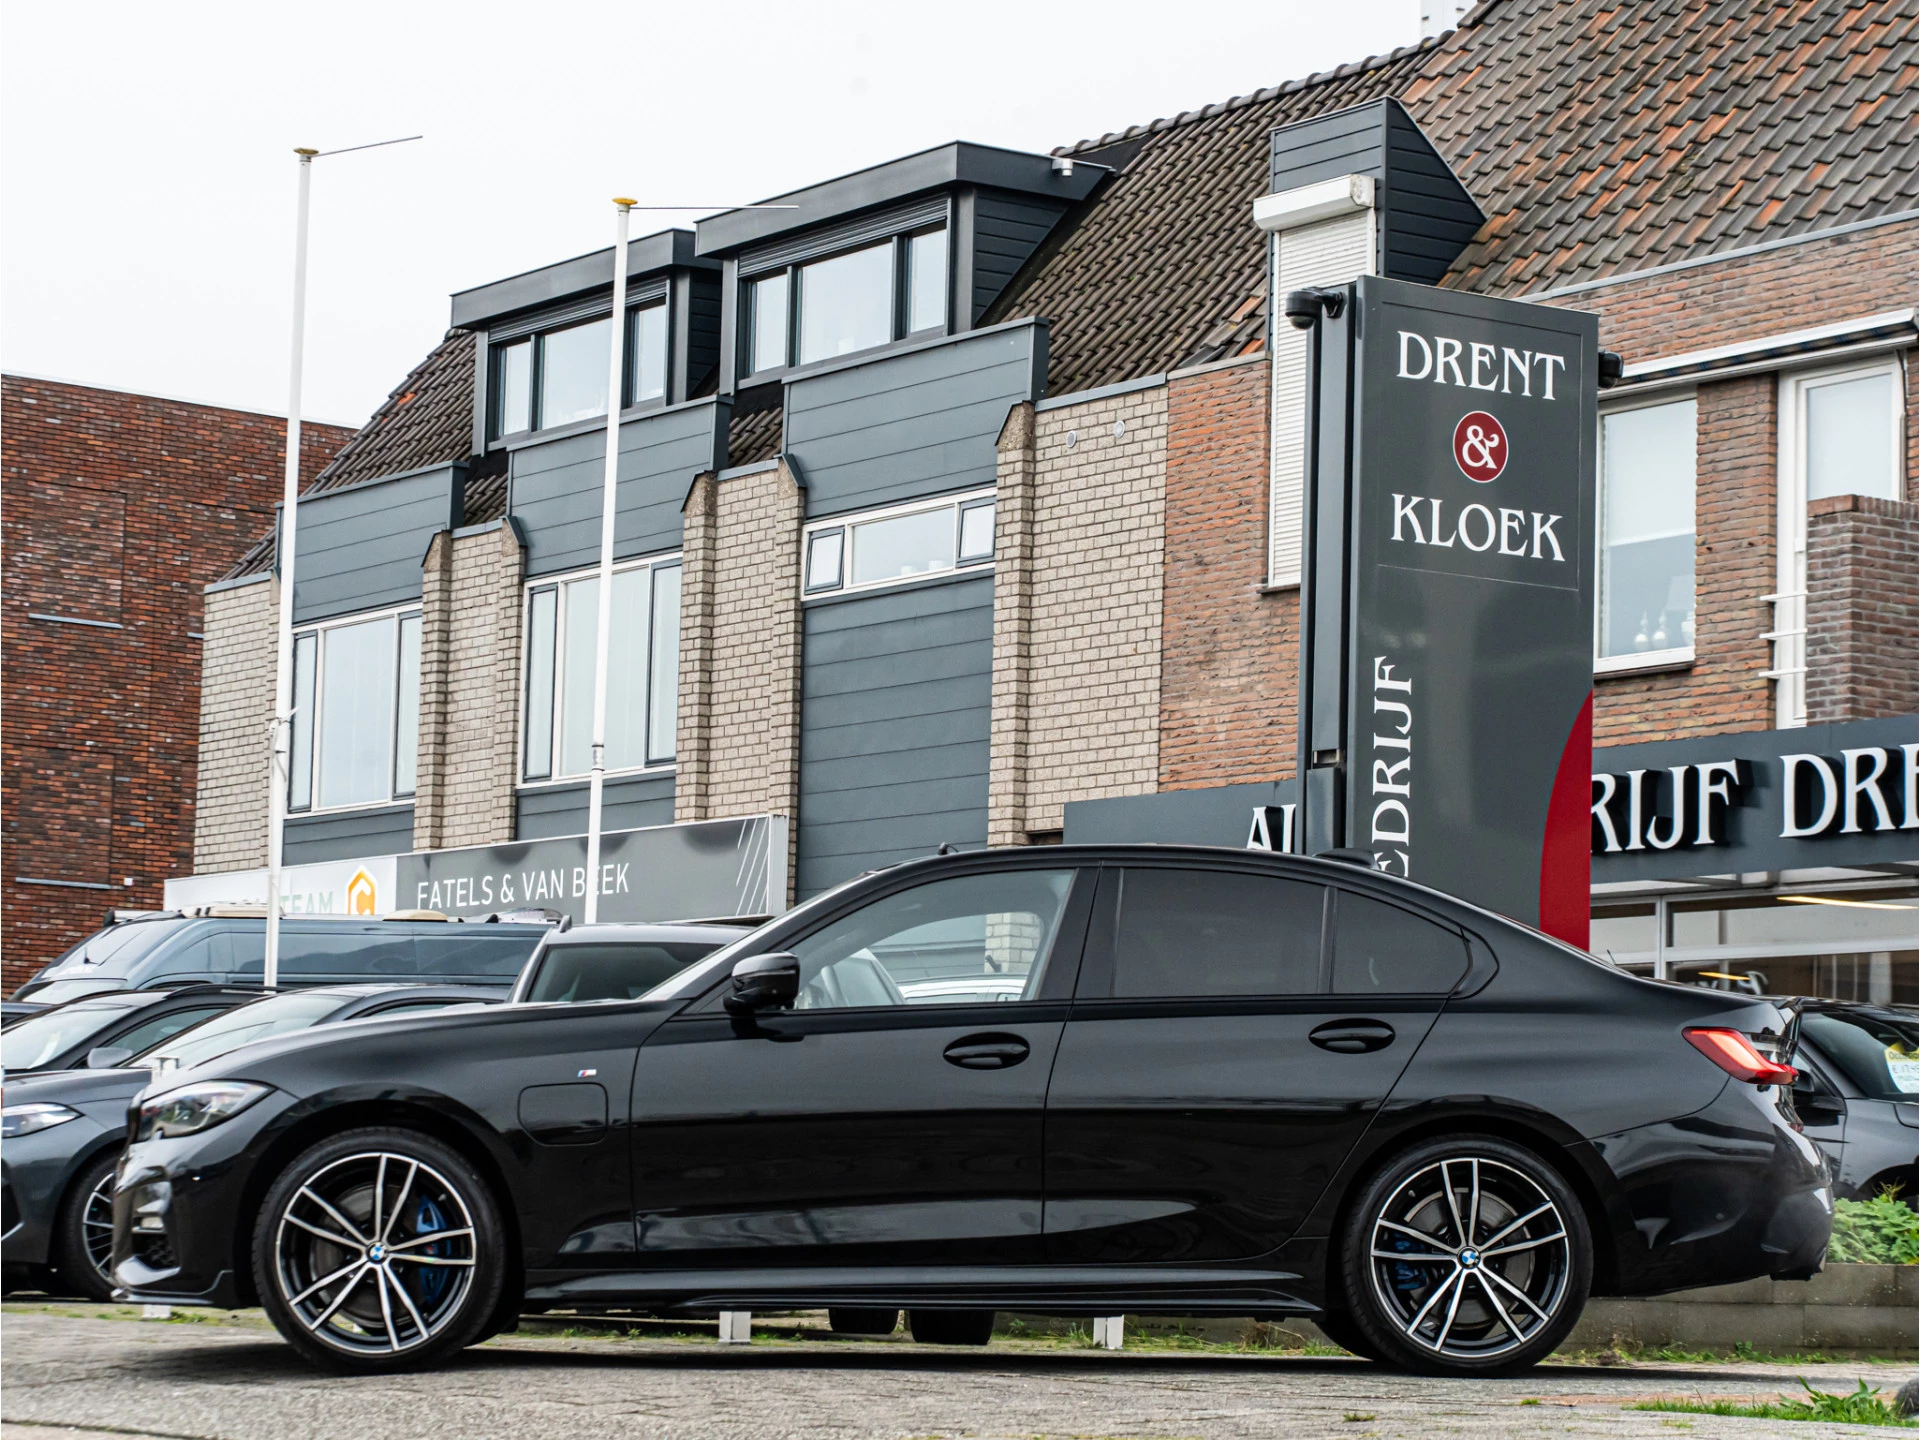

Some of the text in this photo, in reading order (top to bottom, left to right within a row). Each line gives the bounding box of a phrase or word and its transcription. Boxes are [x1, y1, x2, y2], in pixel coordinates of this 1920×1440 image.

[1396, 330, 1566, 401] DRENT
[1461, 424, 1500, 470] &
[1390, 493, 1566, 562] KLOEK
[417, 863, 630, 910] FATELS & VAN BEK
